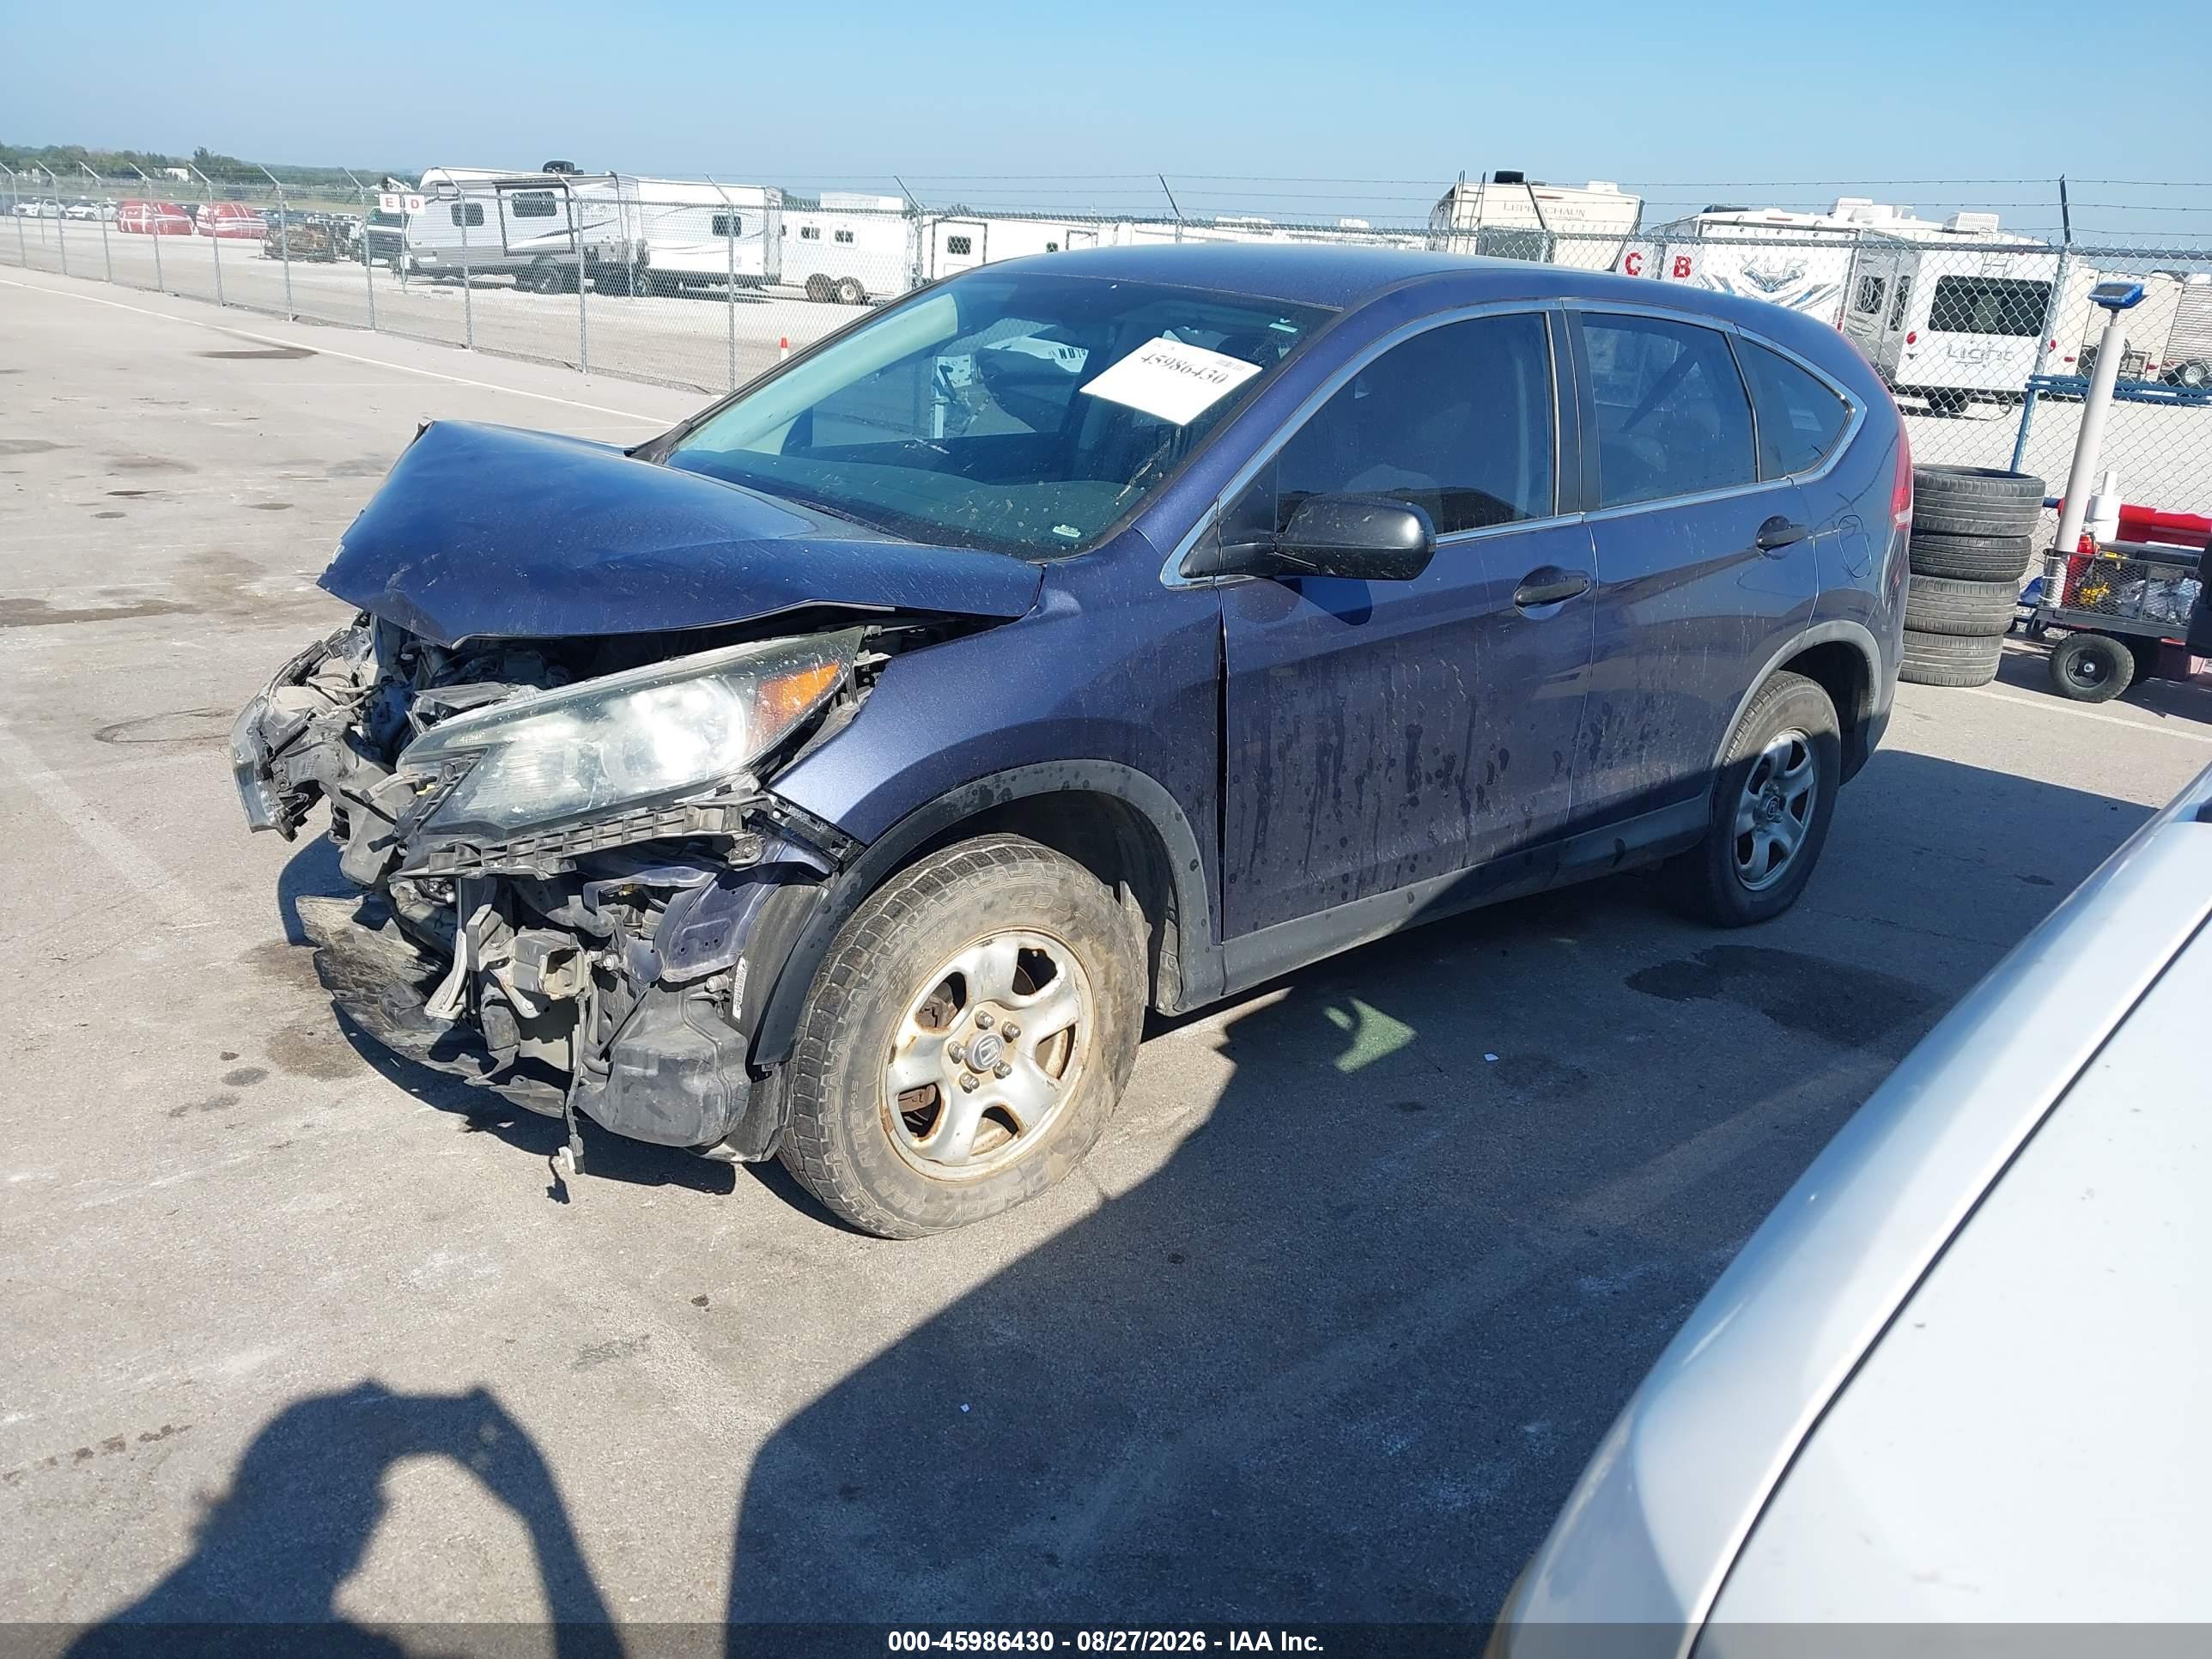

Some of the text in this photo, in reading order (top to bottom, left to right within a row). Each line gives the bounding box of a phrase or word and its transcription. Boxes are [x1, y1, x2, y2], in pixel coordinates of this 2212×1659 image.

[385, 198, 394, 208] E
[410, 198, 420, 209] D
[1503, 202, 1586, 218] LEPRCHAUN
[1625, 252, 1643, 276] C
[1674, 256, 1692, 277] B
[1141, 353, 1229, 384] 45986430
